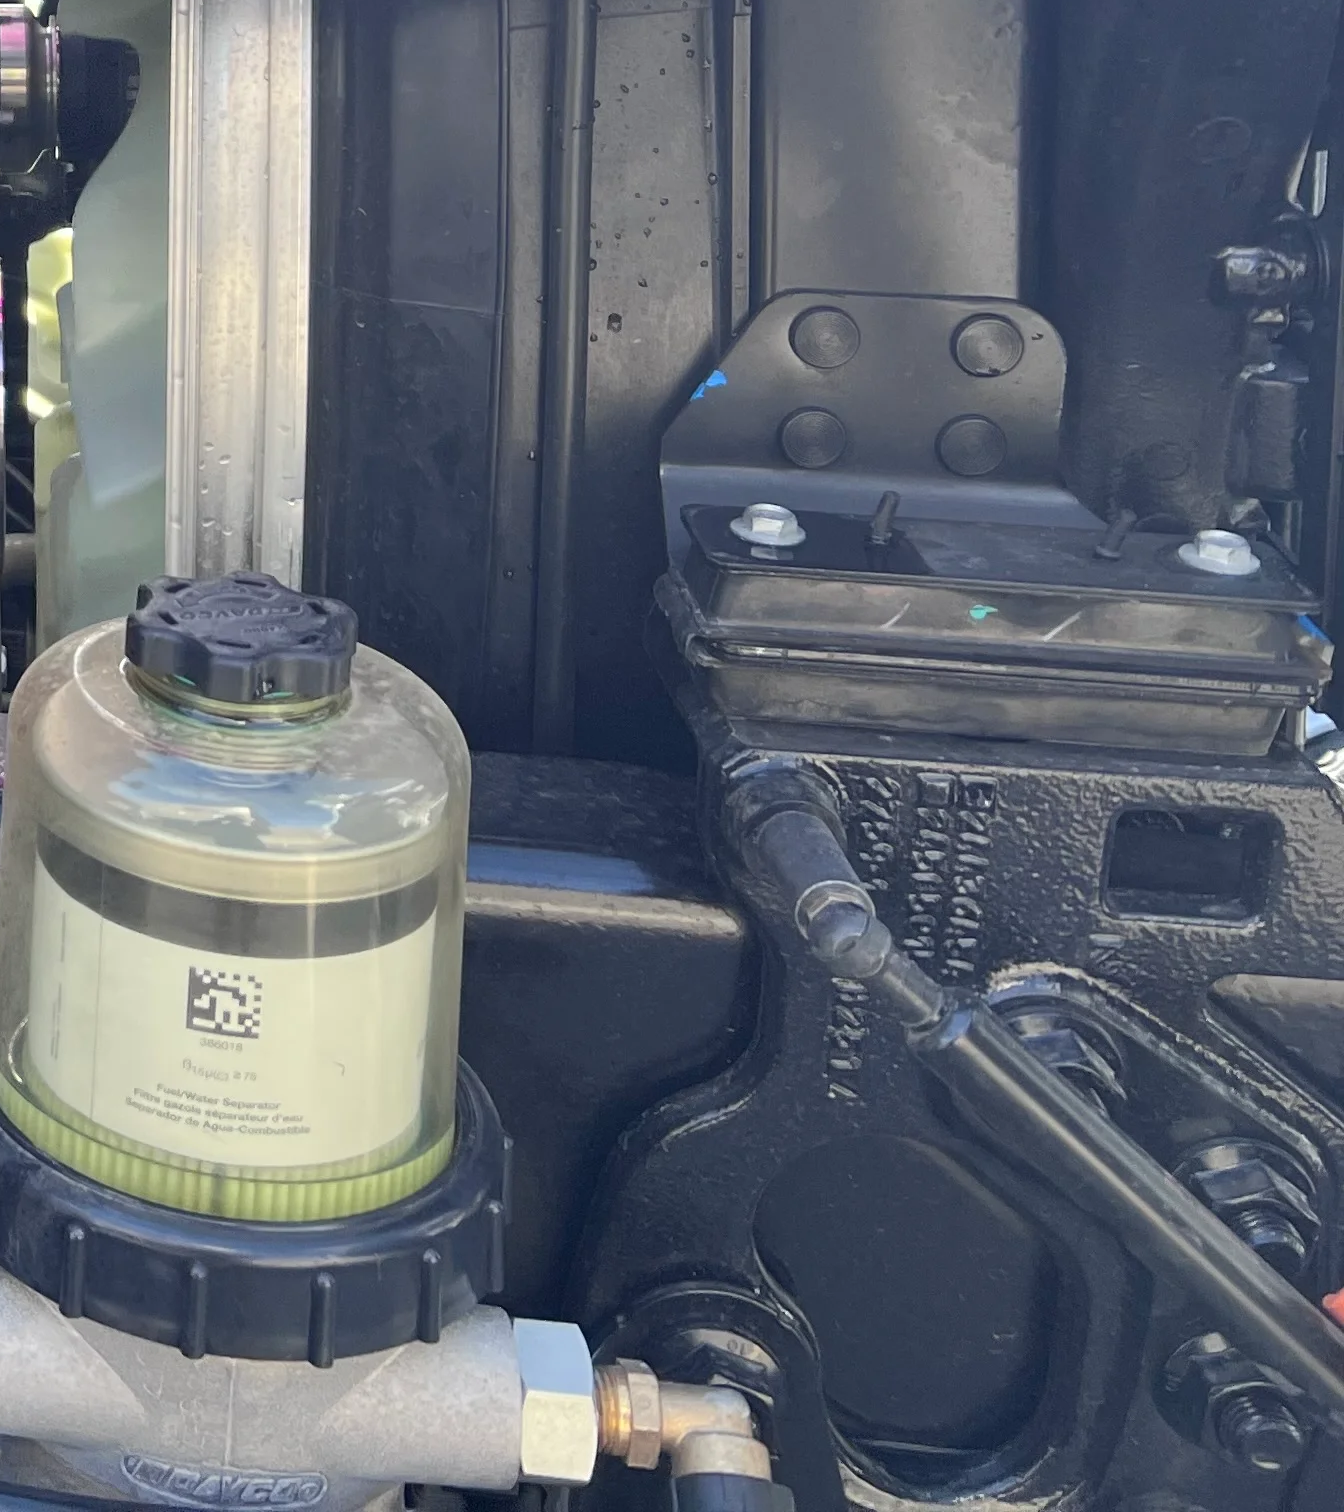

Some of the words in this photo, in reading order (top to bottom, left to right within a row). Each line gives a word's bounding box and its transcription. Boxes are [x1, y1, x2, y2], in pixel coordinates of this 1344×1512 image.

[156, 1083, 219, 1105] Fuel/Water
[222, 1097, 281, 1111] Separator
[184, 1117, 200, 1127] de
